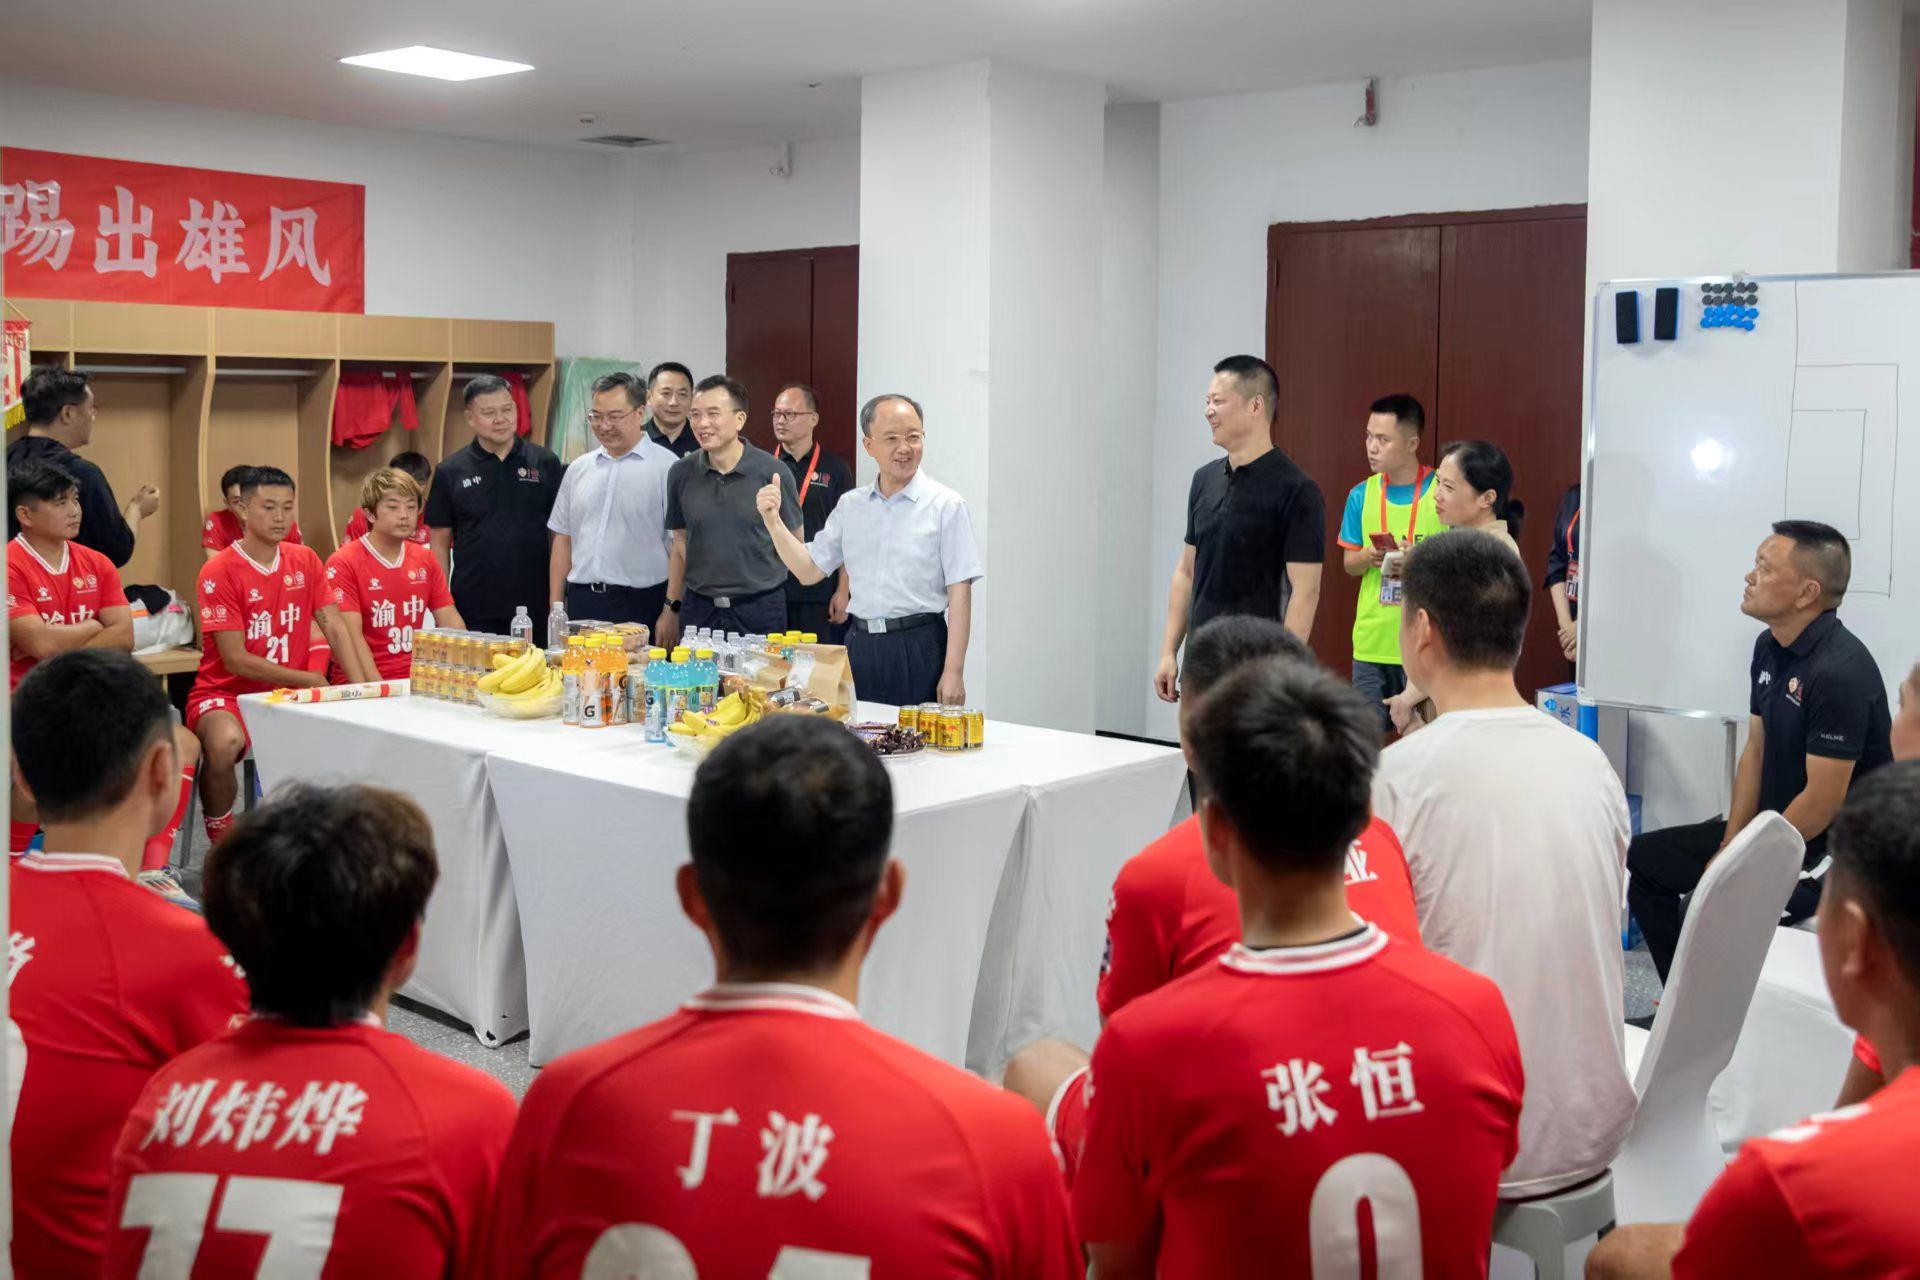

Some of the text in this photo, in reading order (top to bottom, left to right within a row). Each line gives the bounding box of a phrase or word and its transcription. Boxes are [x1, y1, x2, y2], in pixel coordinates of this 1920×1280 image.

[0, 179, 332, 288] 踢出雄风
[247, 602, 301, 640] 渝中
[371, 594, 425, 628] 渝中
[265, 633, 290, 665] 21
[387, 625, 413, 655] 30
[584, 705, 596, 718] G
[1260, 1040, 1425, 1137] 张恒
[140, 1078, 369, 1155] 刘炜烨
[671, 1107, 836, 1202] 丁波
